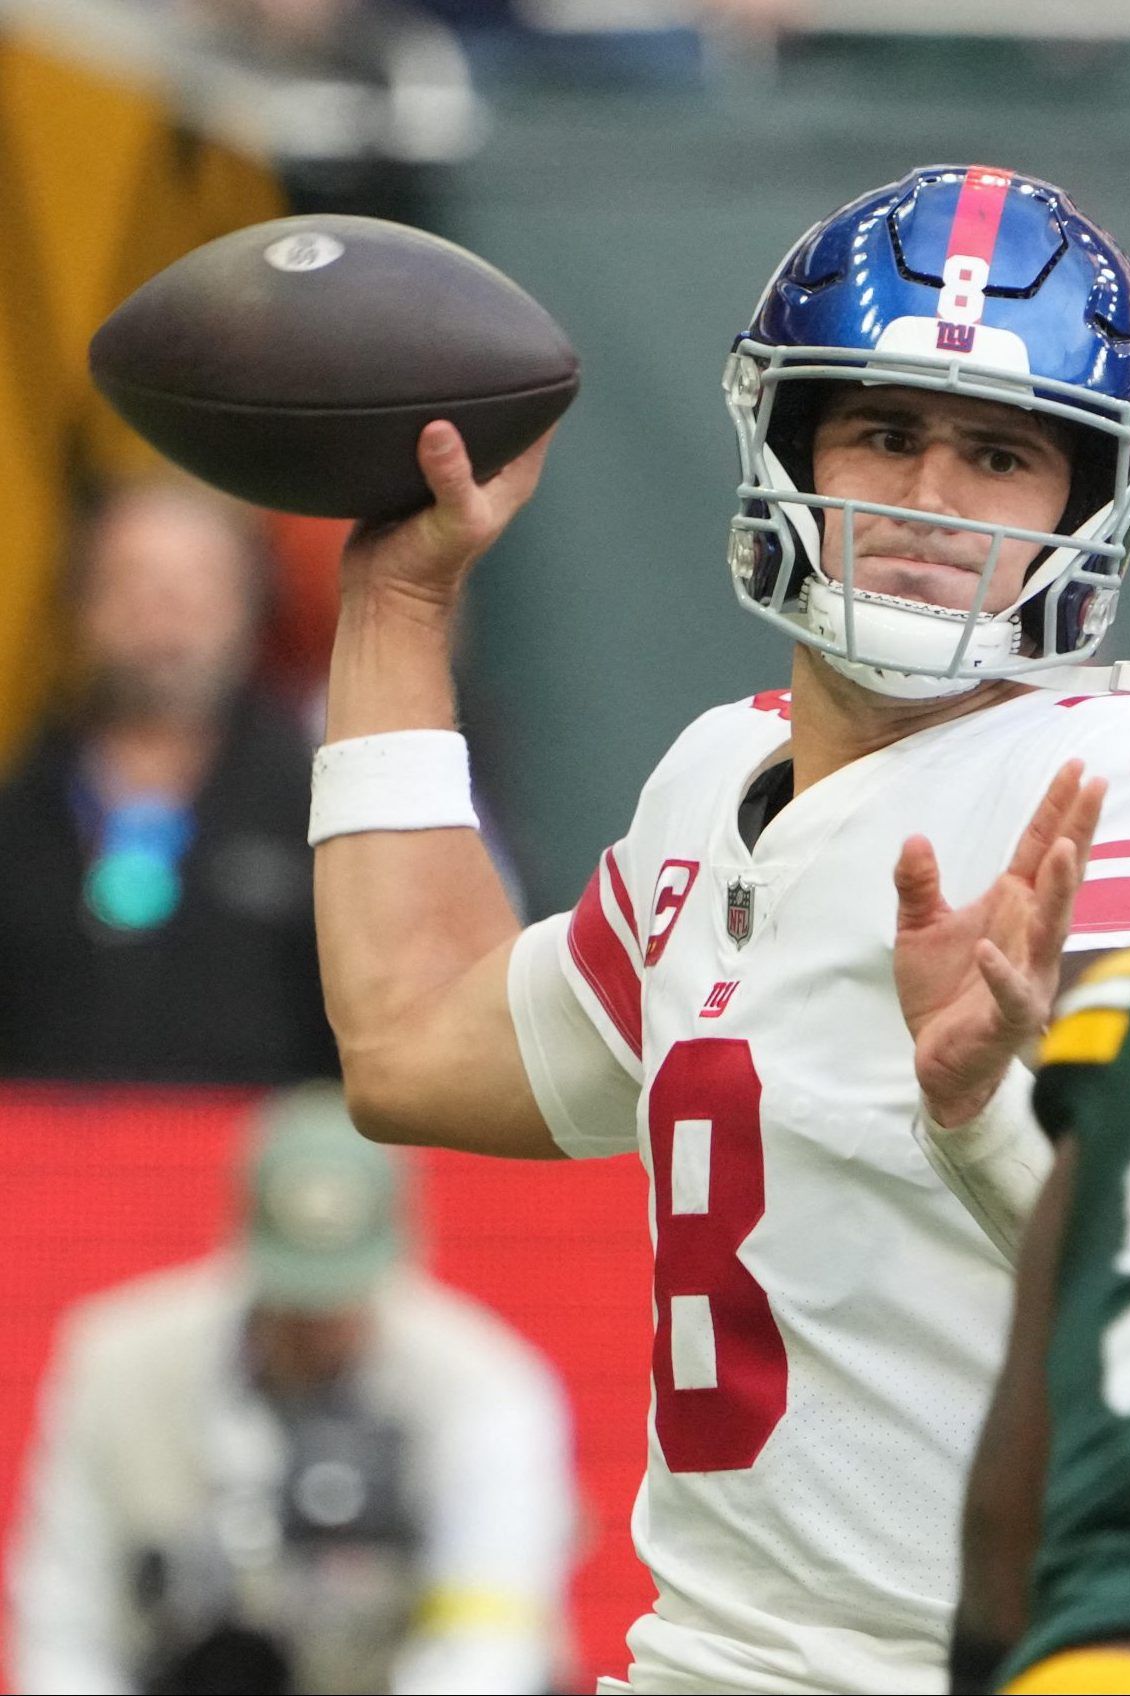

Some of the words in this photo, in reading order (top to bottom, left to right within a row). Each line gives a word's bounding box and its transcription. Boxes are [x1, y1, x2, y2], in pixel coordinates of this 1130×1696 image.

[937, 253, 991, 325] 8
[650, 864, 692, 937] C
[728, 907, 750, 936] NFL
[649, 1038, 789, 1473] 8
